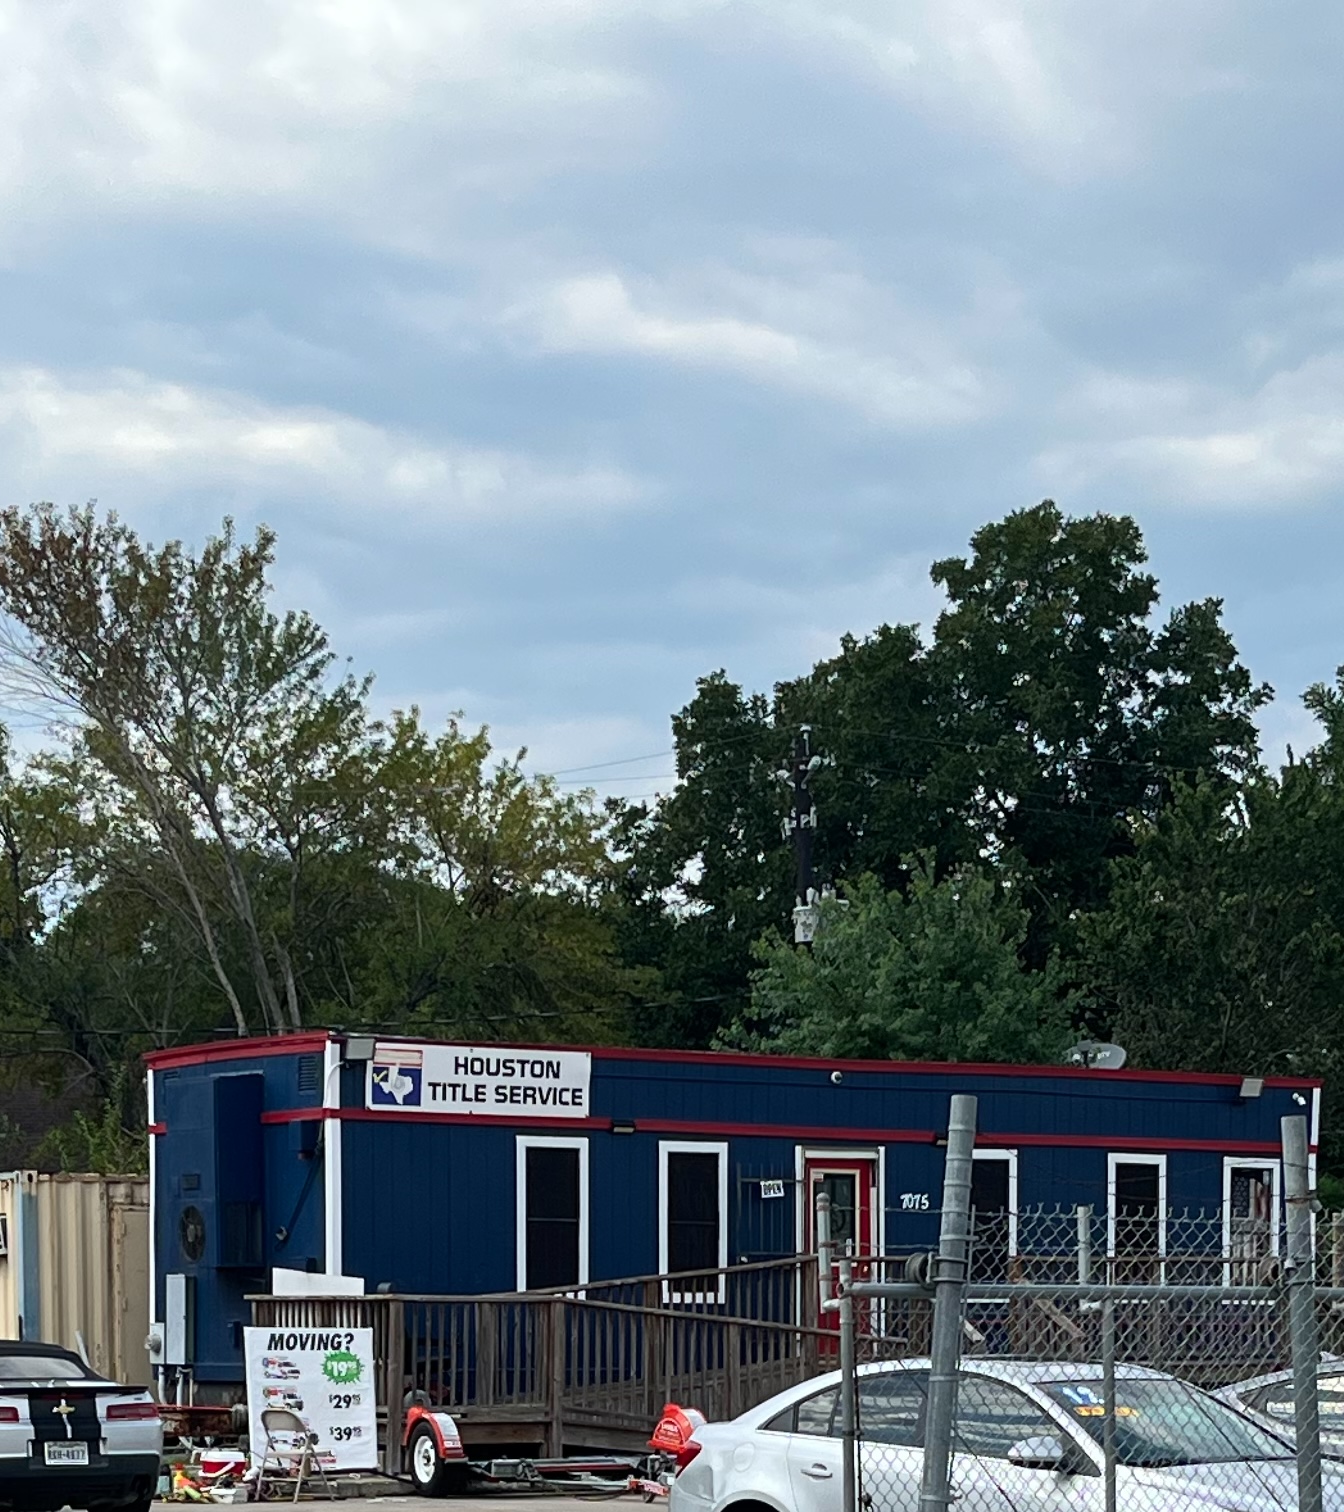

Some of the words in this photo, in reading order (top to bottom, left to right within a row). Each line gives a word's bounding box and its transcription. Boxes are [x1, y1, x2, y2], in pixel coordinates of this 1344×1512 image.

[454, 1056, 561, 1079] HOUSTON
[428, 1082, 486, 1102] TITLE
[494, 1085, 583, 1106] SERVICE
[900, 1193, 930, 1211] 7075
[267, 1332, 355, 1351] MOVING?
